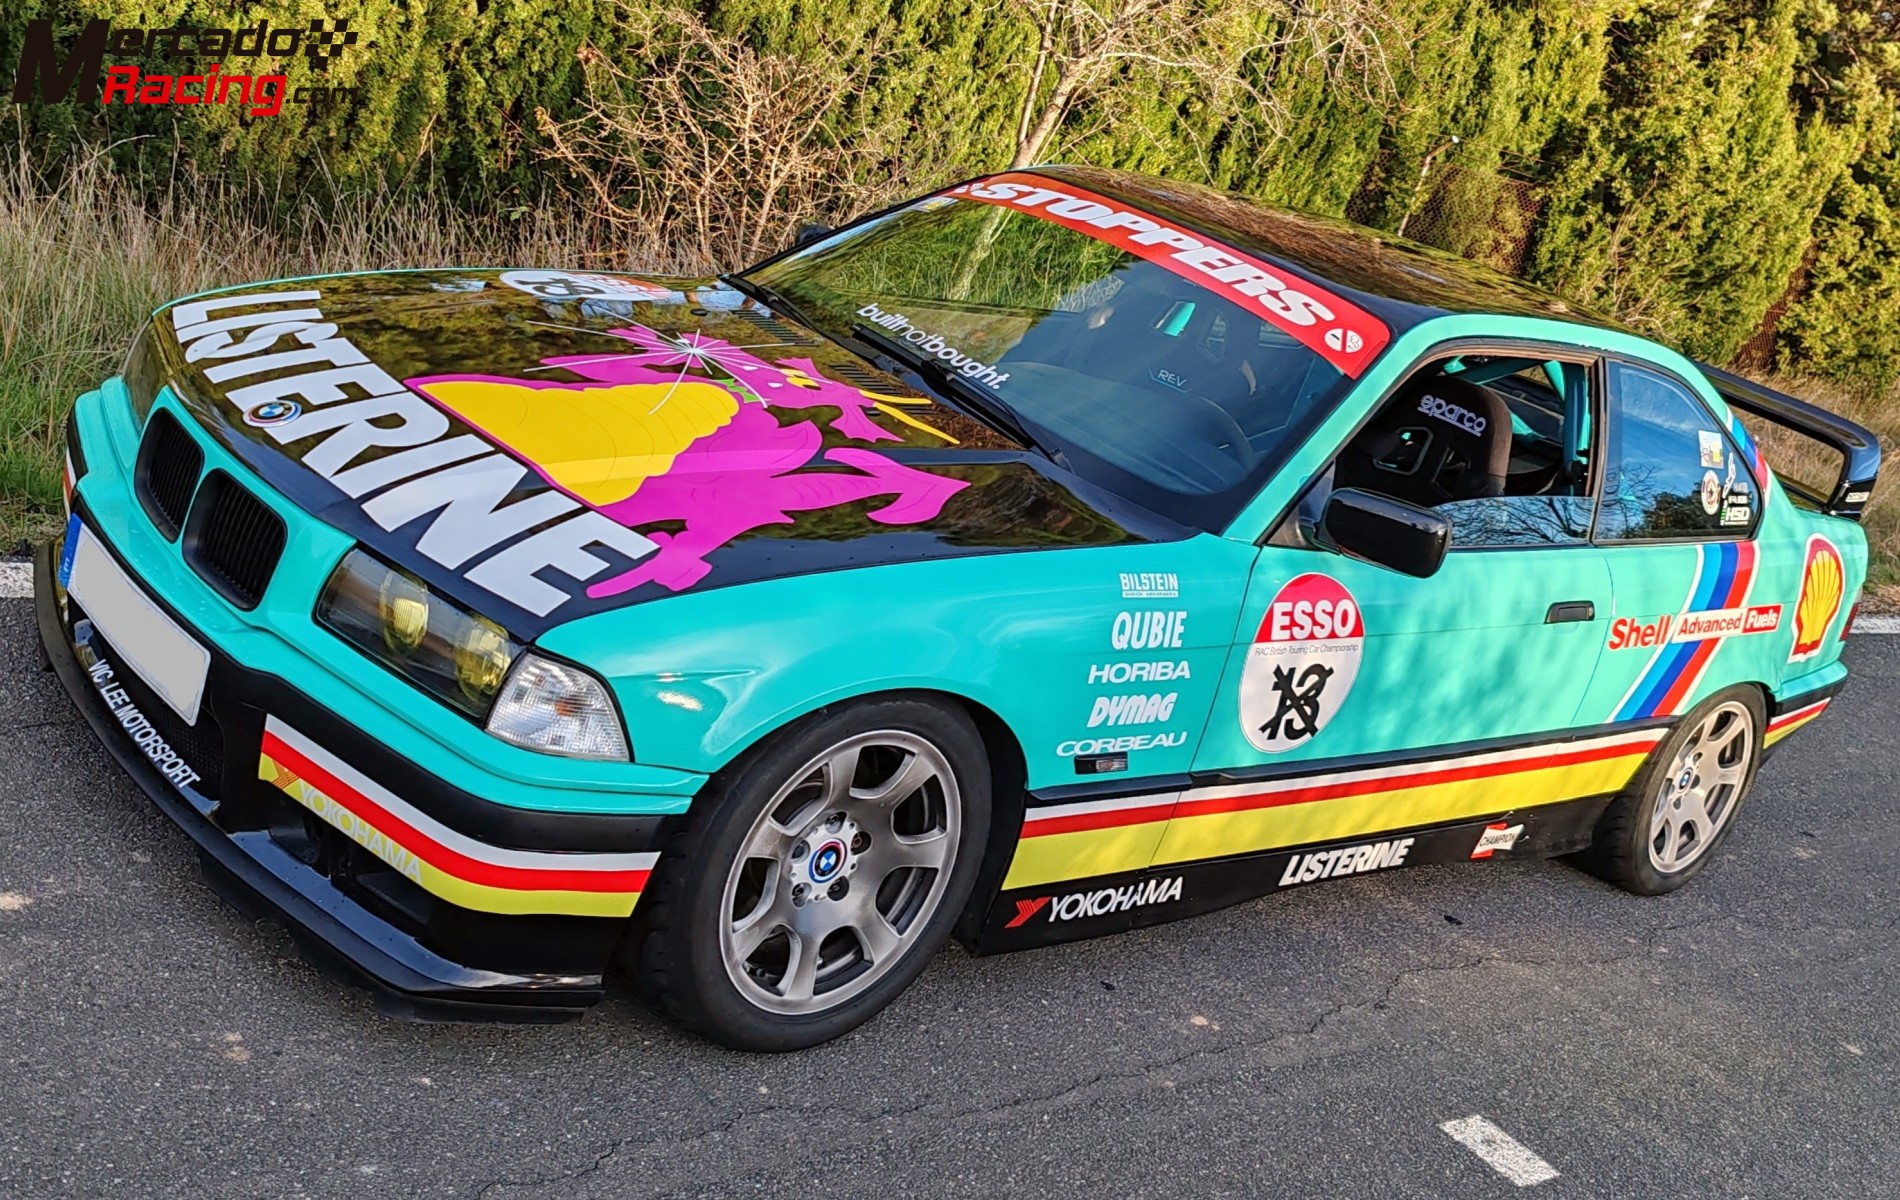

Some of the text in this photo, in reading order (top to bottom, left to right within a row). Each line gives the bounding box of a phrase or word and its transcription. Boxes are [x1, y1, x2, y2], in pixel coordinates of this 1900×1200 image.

[1158, 369, 1187, 387] REV
[1419, 394, 1487, 433] sparco
[173, 290, 661, 617] LISTERINE
[1119, 573, 1178, 590] BILSTEIN
[1111, 611, 1187, 650] QUBIE
[1270, 598, 1357, 640] ESSO
[1608, 608, 1780, 650] Shell Advanced Fuels
[1087, 660, 1191, 684] HORIBA
[88, 659, 201, 788] VIC LEE MOTORSPORT
[1086, 692, 1178, 728] DYMAG
[1056, 731, 1187, 757] CORBEAU
[299, 779, 424, 886] YOKOHAMA
[1278, 838, 1415, 886] LISTERINE
[1048, 876, 1183, 922] YOKOHAMA
